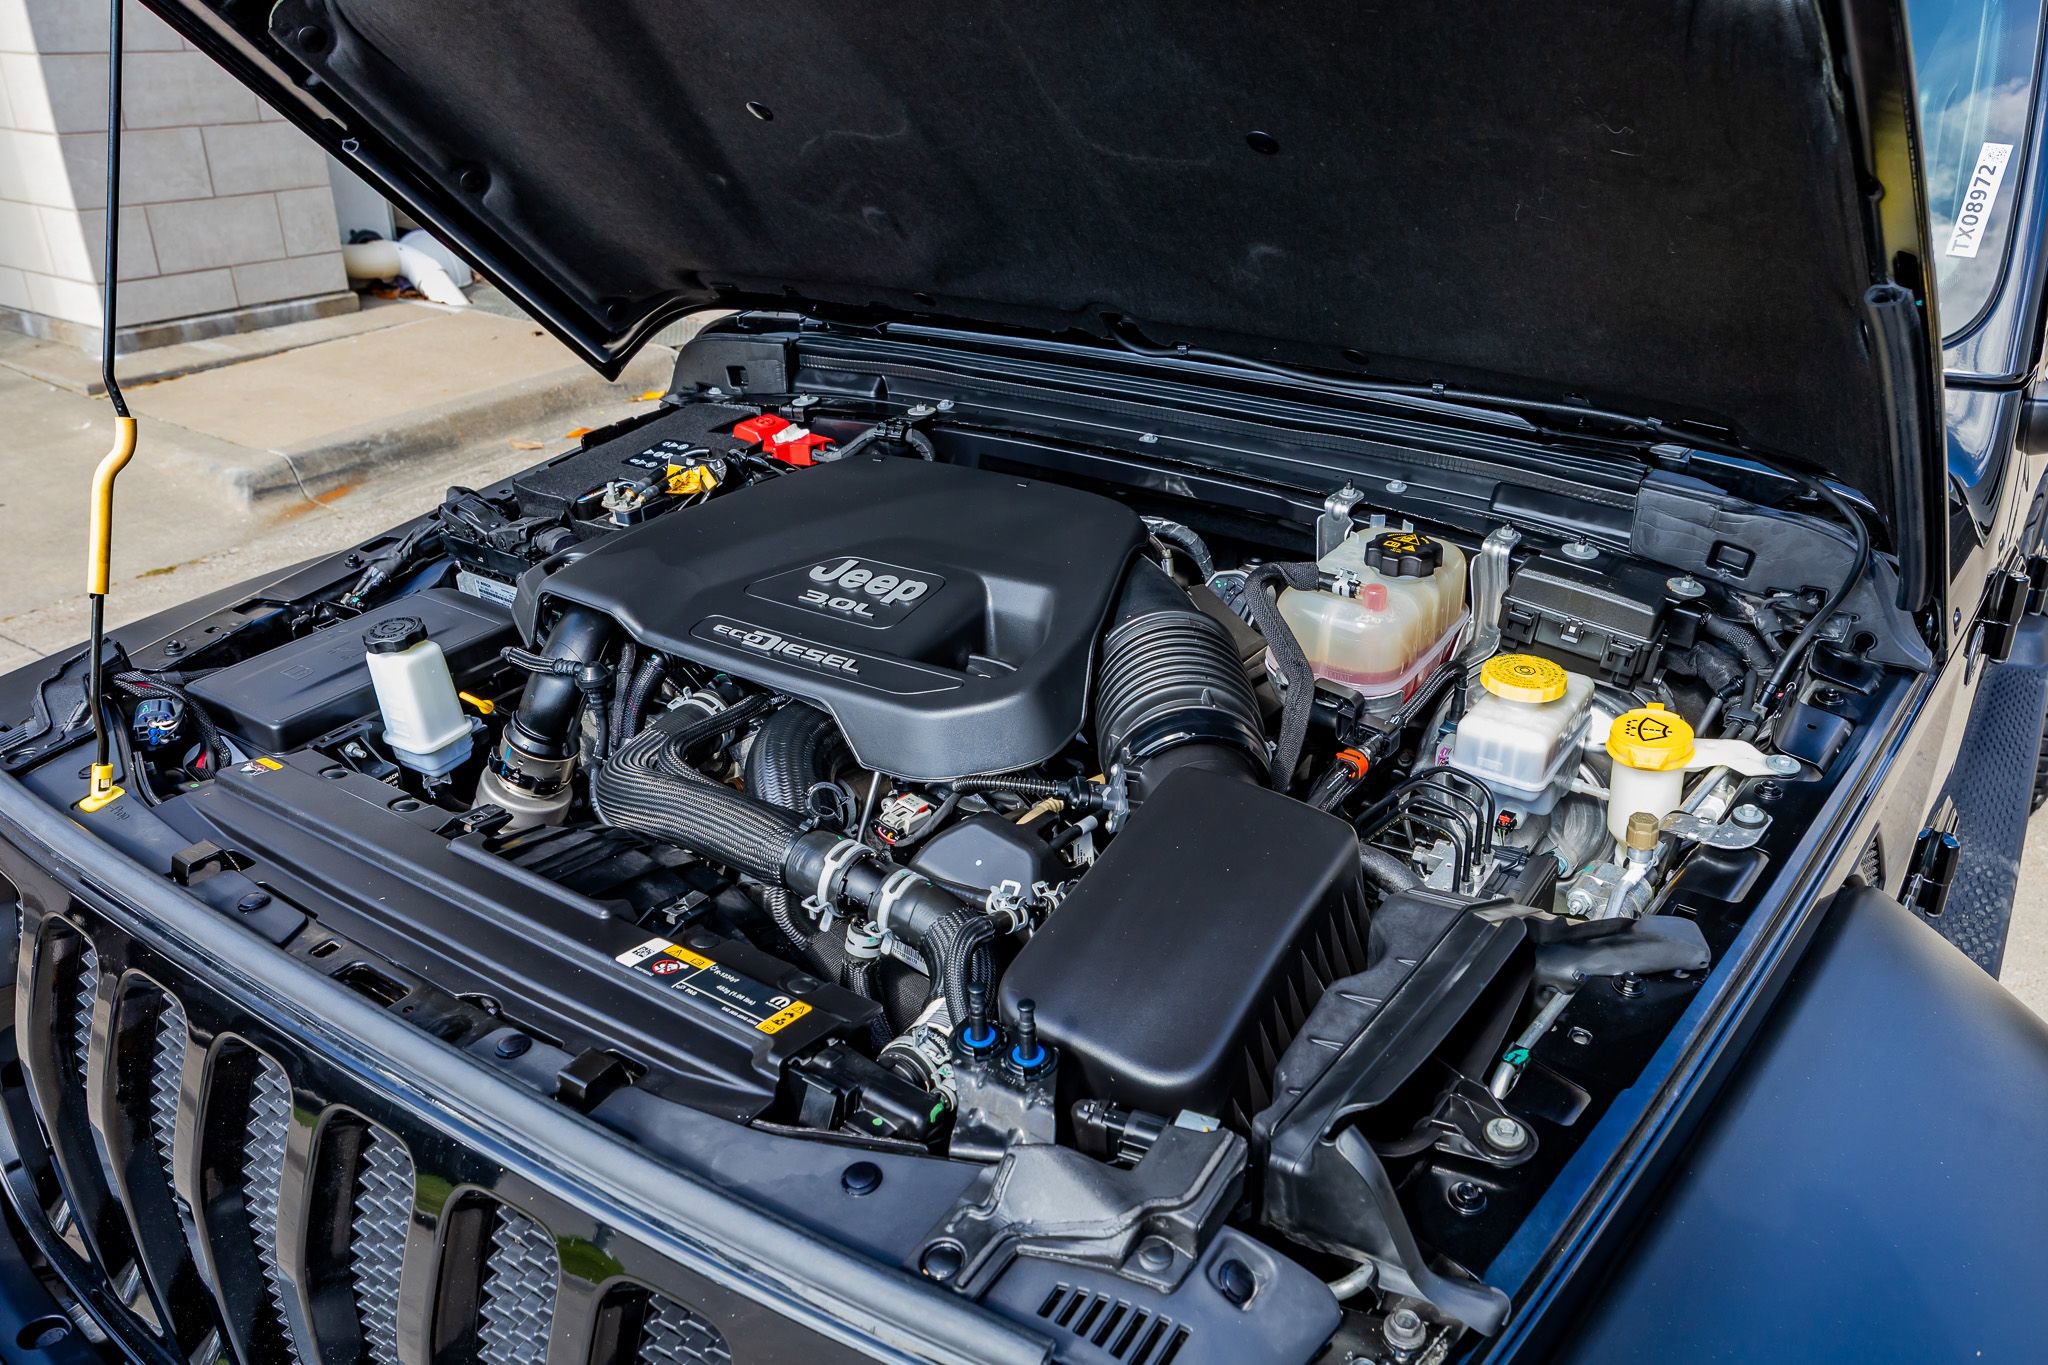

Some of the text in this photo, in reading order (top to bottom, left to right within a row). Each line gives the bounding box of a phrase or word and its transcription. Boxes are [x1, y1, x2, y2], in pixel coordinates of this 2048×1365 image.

[1952, 164, 1997, 252] TX08972
[798, 589, 875, 618] 3.0L
[809, 559, 928, 606] Jeep
